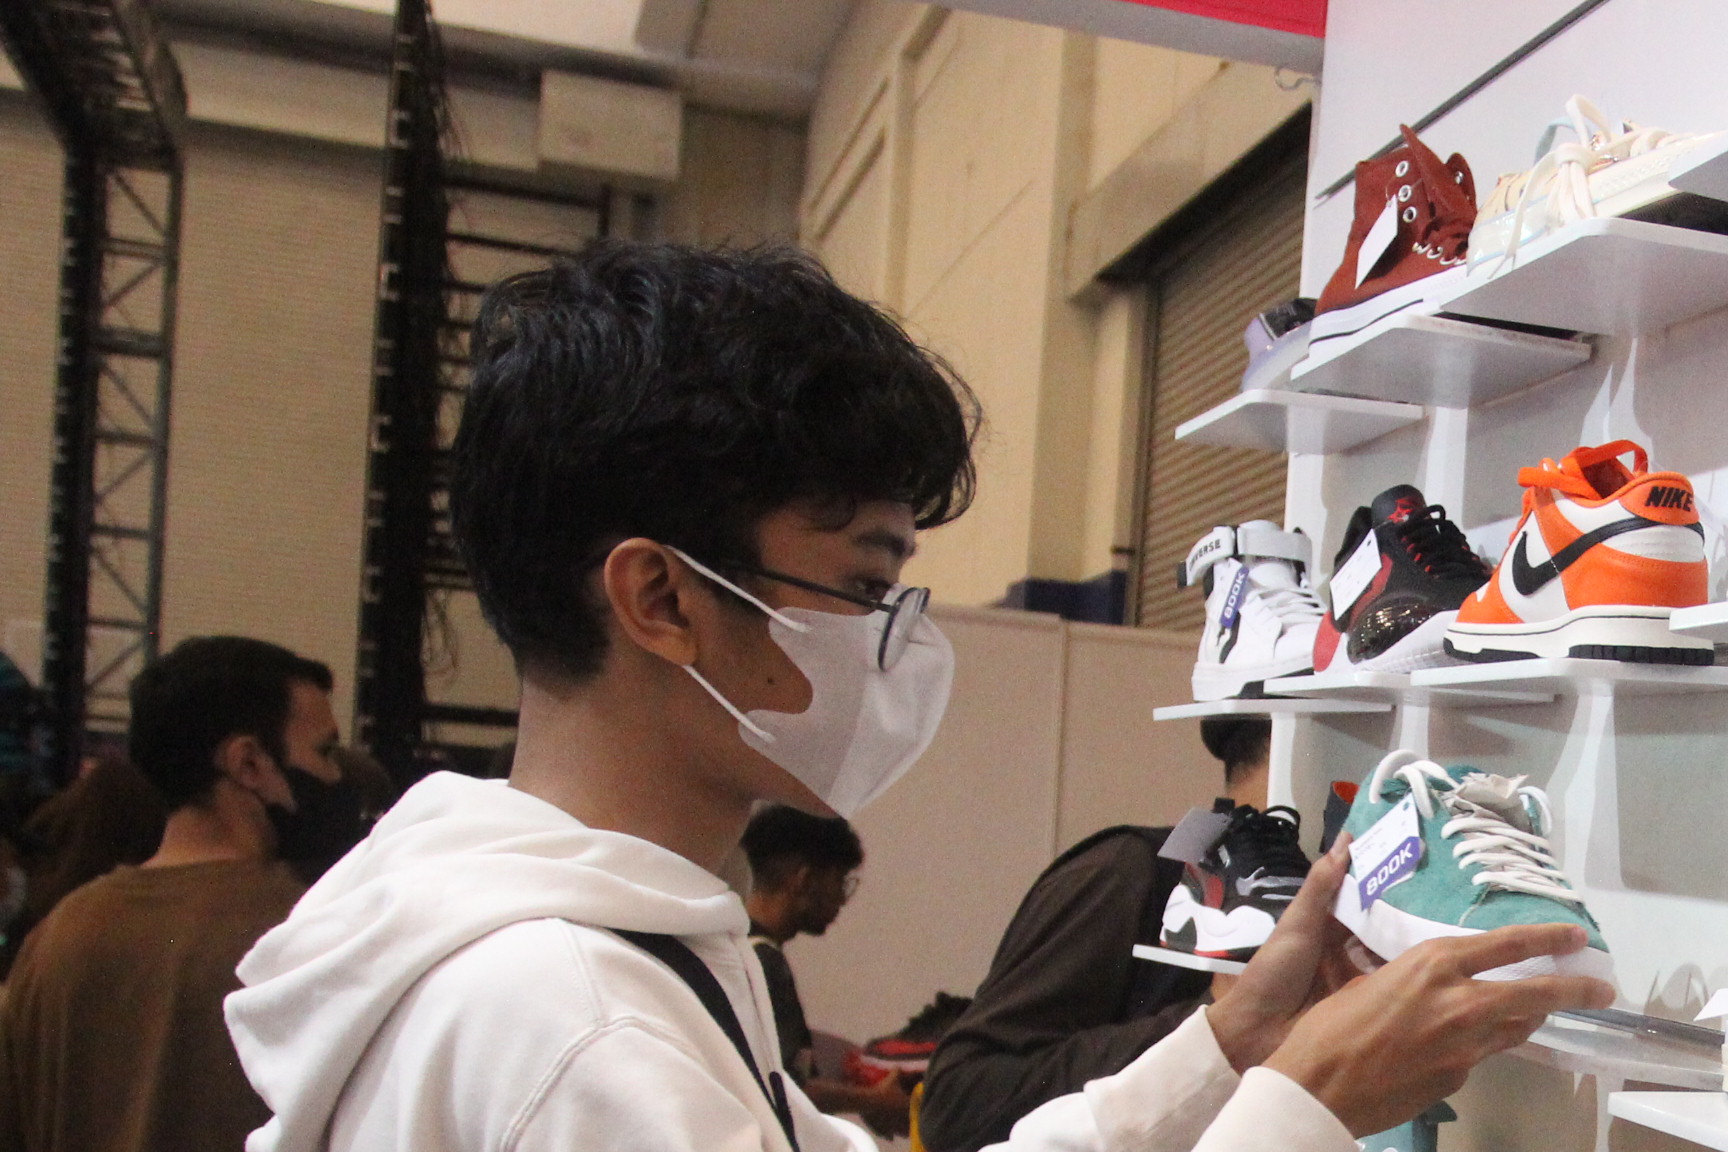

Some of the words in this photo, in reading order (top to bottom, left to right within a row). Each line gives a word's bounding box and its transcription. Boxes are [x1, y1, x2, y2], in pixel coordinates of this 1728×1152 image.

[1645, 486, 1693, 512] NIKE
[1224, 571, 1246, 619] 800K
[1366, 842, 1413, 896] 800K
